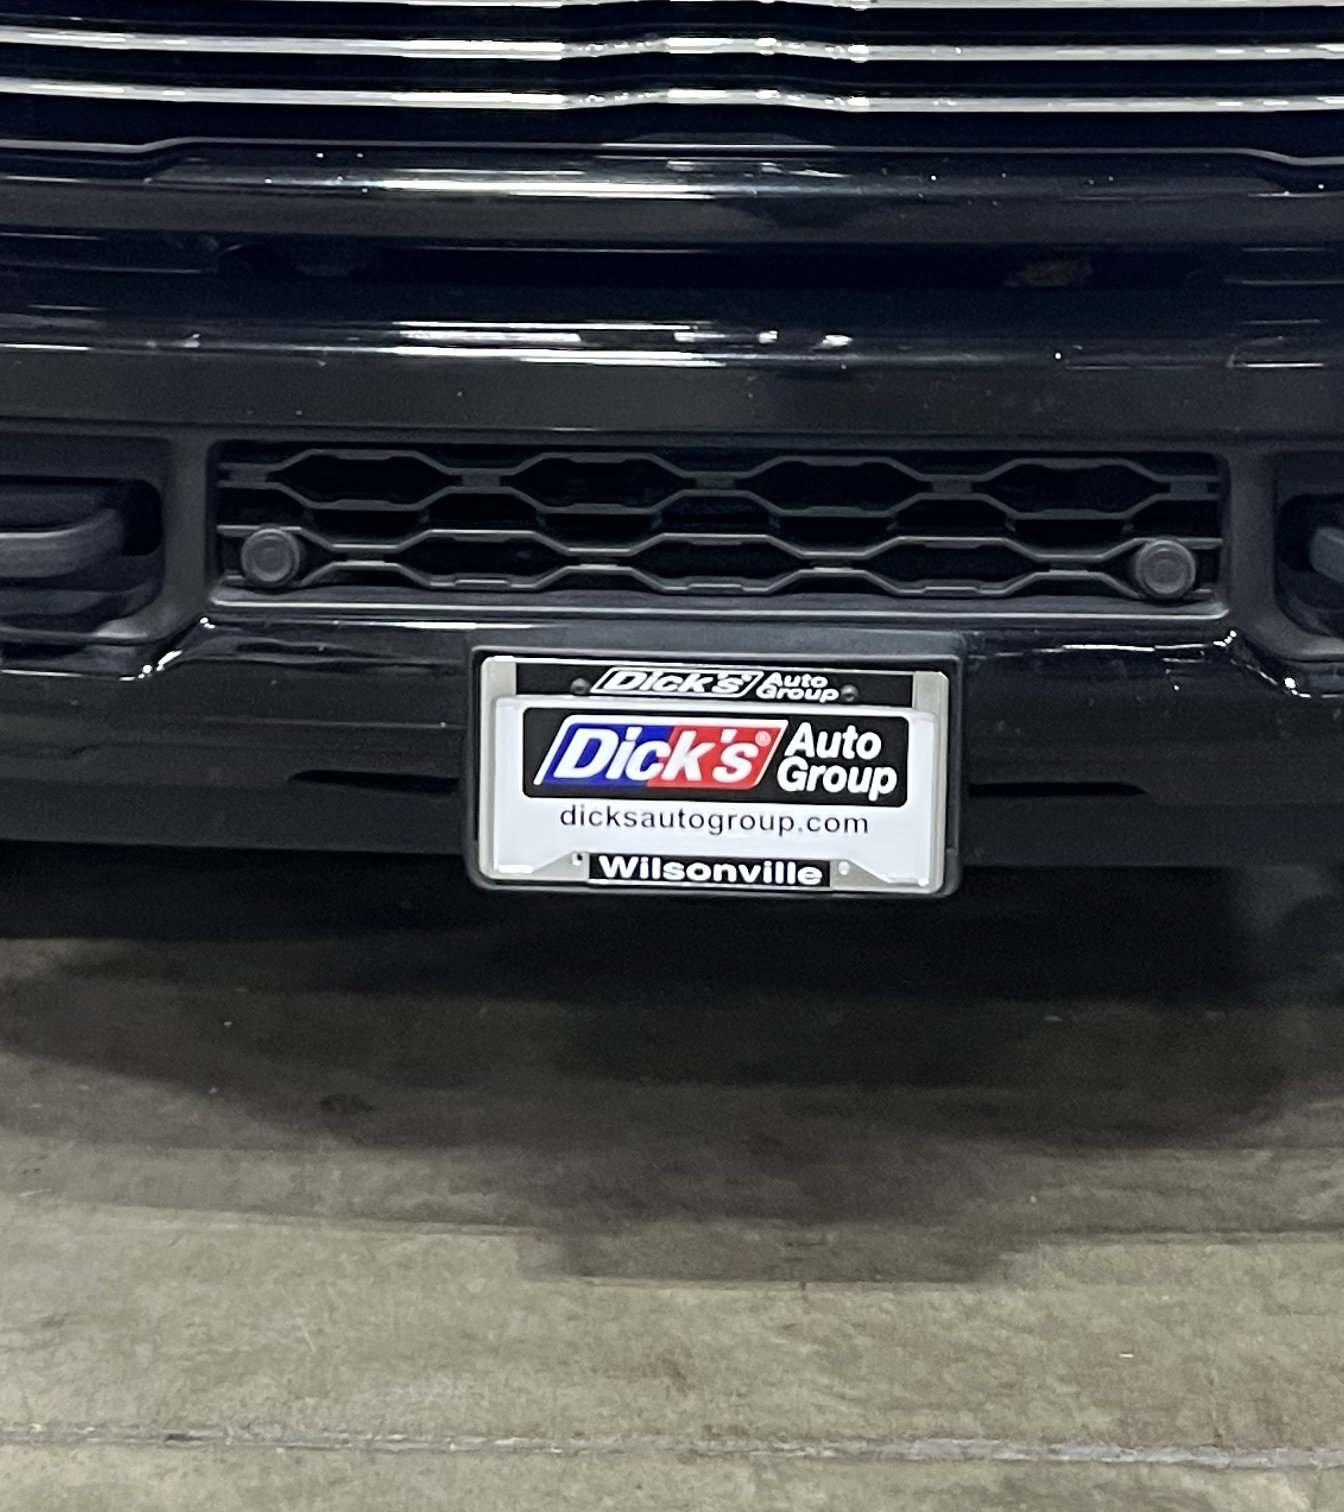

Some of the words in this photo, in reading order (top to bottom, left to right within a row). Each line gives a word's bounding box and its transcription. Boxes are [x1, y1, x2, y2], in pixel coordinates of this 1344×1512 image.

[756, 685, 840, 703] Group
[761, 672, 829, 689] Auto
[553, 727, 759, 787] Dick's
[783, 721, 882, 761] Auto
[776, 761, 898, 802] Group
[559, 804, 869, 835] dicksautogroup.com
[598, 854, 823, 886] Wilsonville
